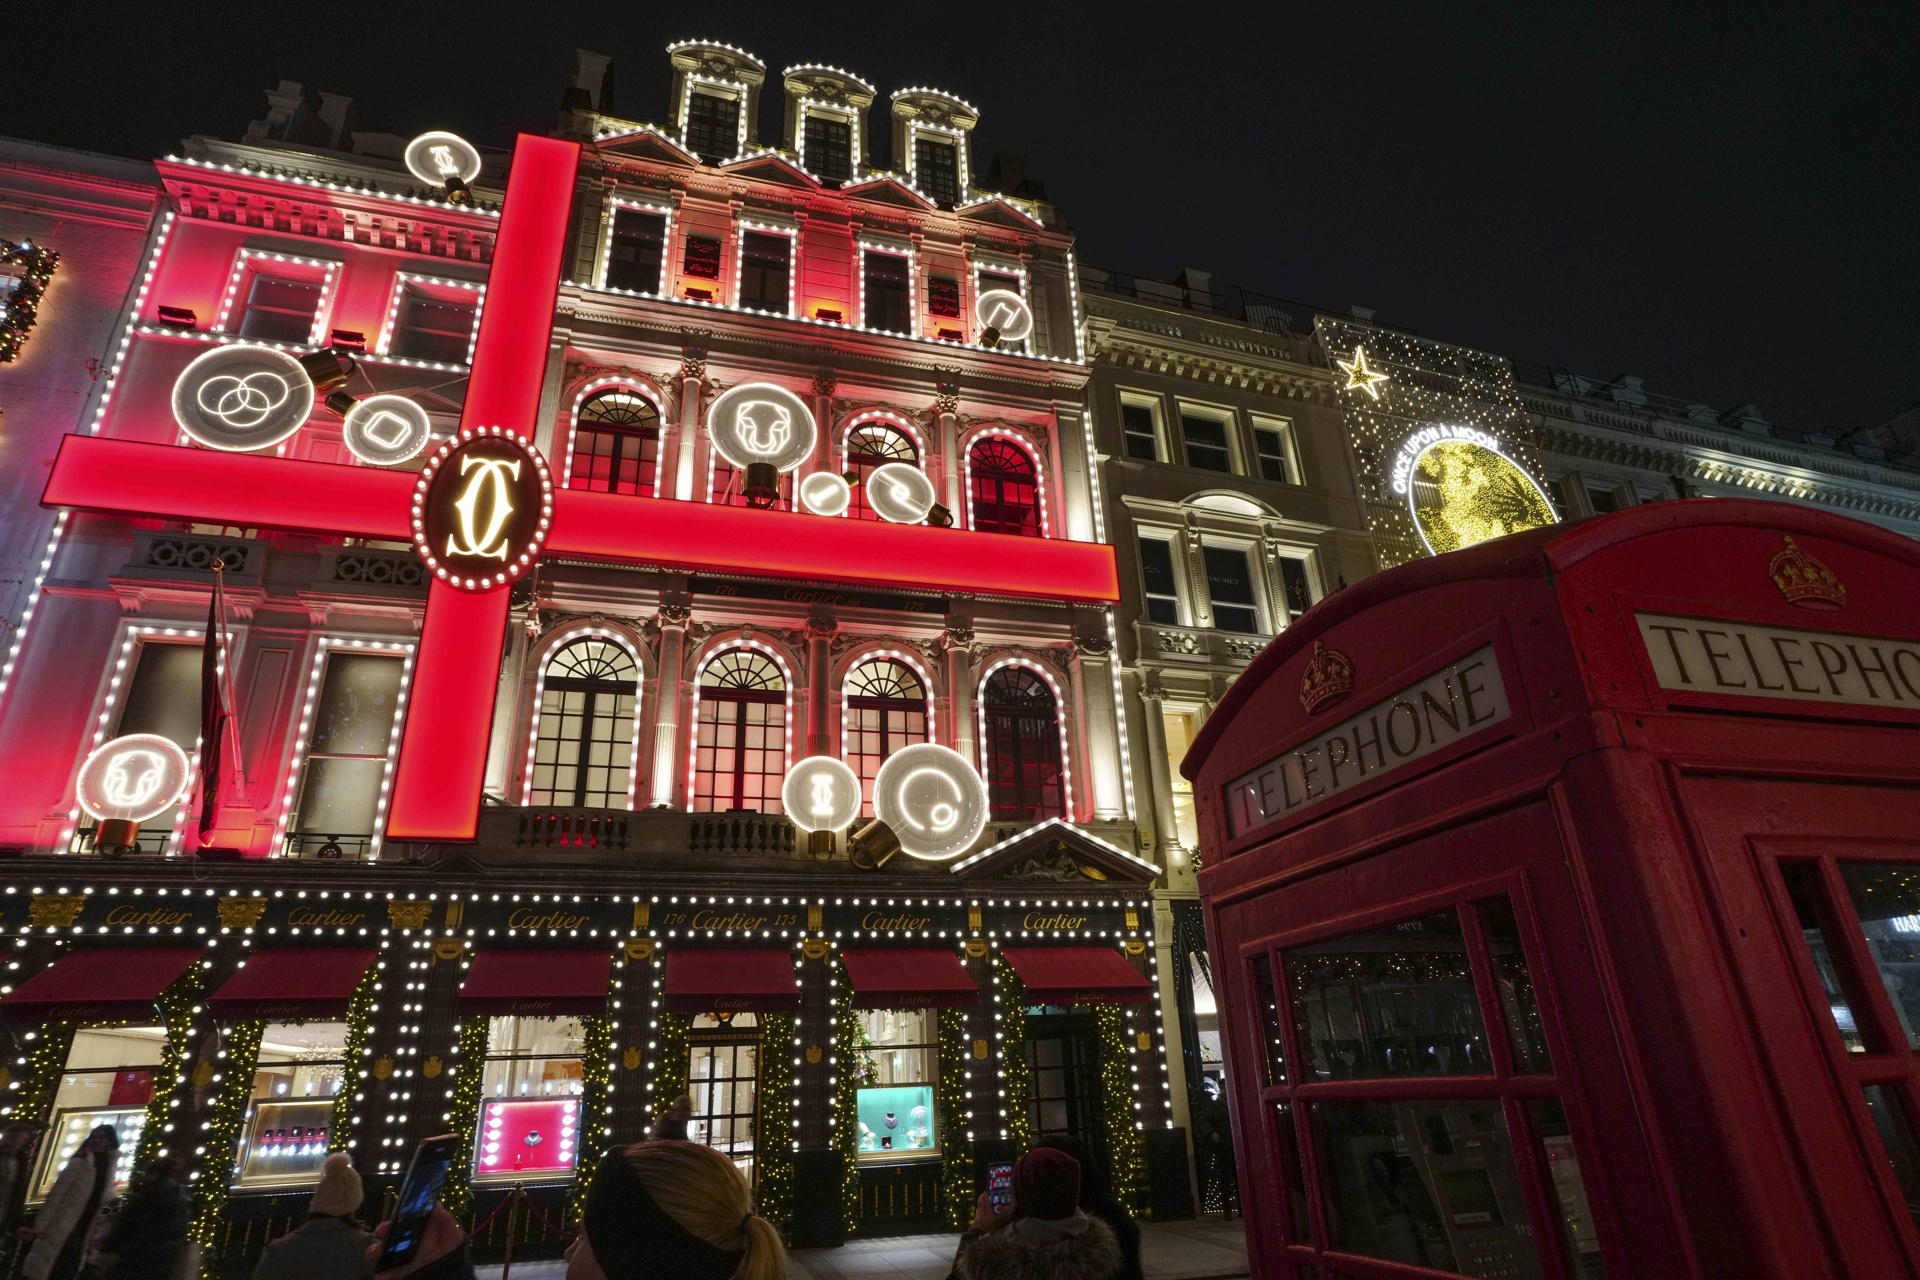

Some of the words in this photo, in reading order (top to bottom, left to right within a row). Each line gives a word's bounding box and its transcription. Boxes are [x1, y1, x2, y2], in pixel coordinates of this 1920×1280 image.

[1393, 450, 1412, 494] ONCE
[1403, 425, 1440, 455] UPON
[1440, 423, 1451, 438] A
[1451, 425, 1499, 451] MOON
[1209, 575, 1240, 585] AUMET
[713, 584, 739, 597] 176
[783, 586, 844, 606] Cartier
[903, 600, 925, 612] 175
[1234, 660, 1496, 829] TELEPHONE
[106, 904, 193, 926] Cartier
[288, 906, 366, 926] Cartier
[508, 907, 591, 929] Cartier
[662, 913, 686, 925] 176
[691, 909, 768, 930] Cartier
[774, 913, 798, 926] 175
[861, 911, 931, 930] Cartier
[1023, 911, 1087, 930] Cartier
[1892, 914, 1920, 932] HAR
[254, 1002, 302, 1015] Cartier
[511, 999, 555, 1011] Cartier
[713, 997, 752, 1008] Cartier
[900, 994, 935, 1004] Cartier
